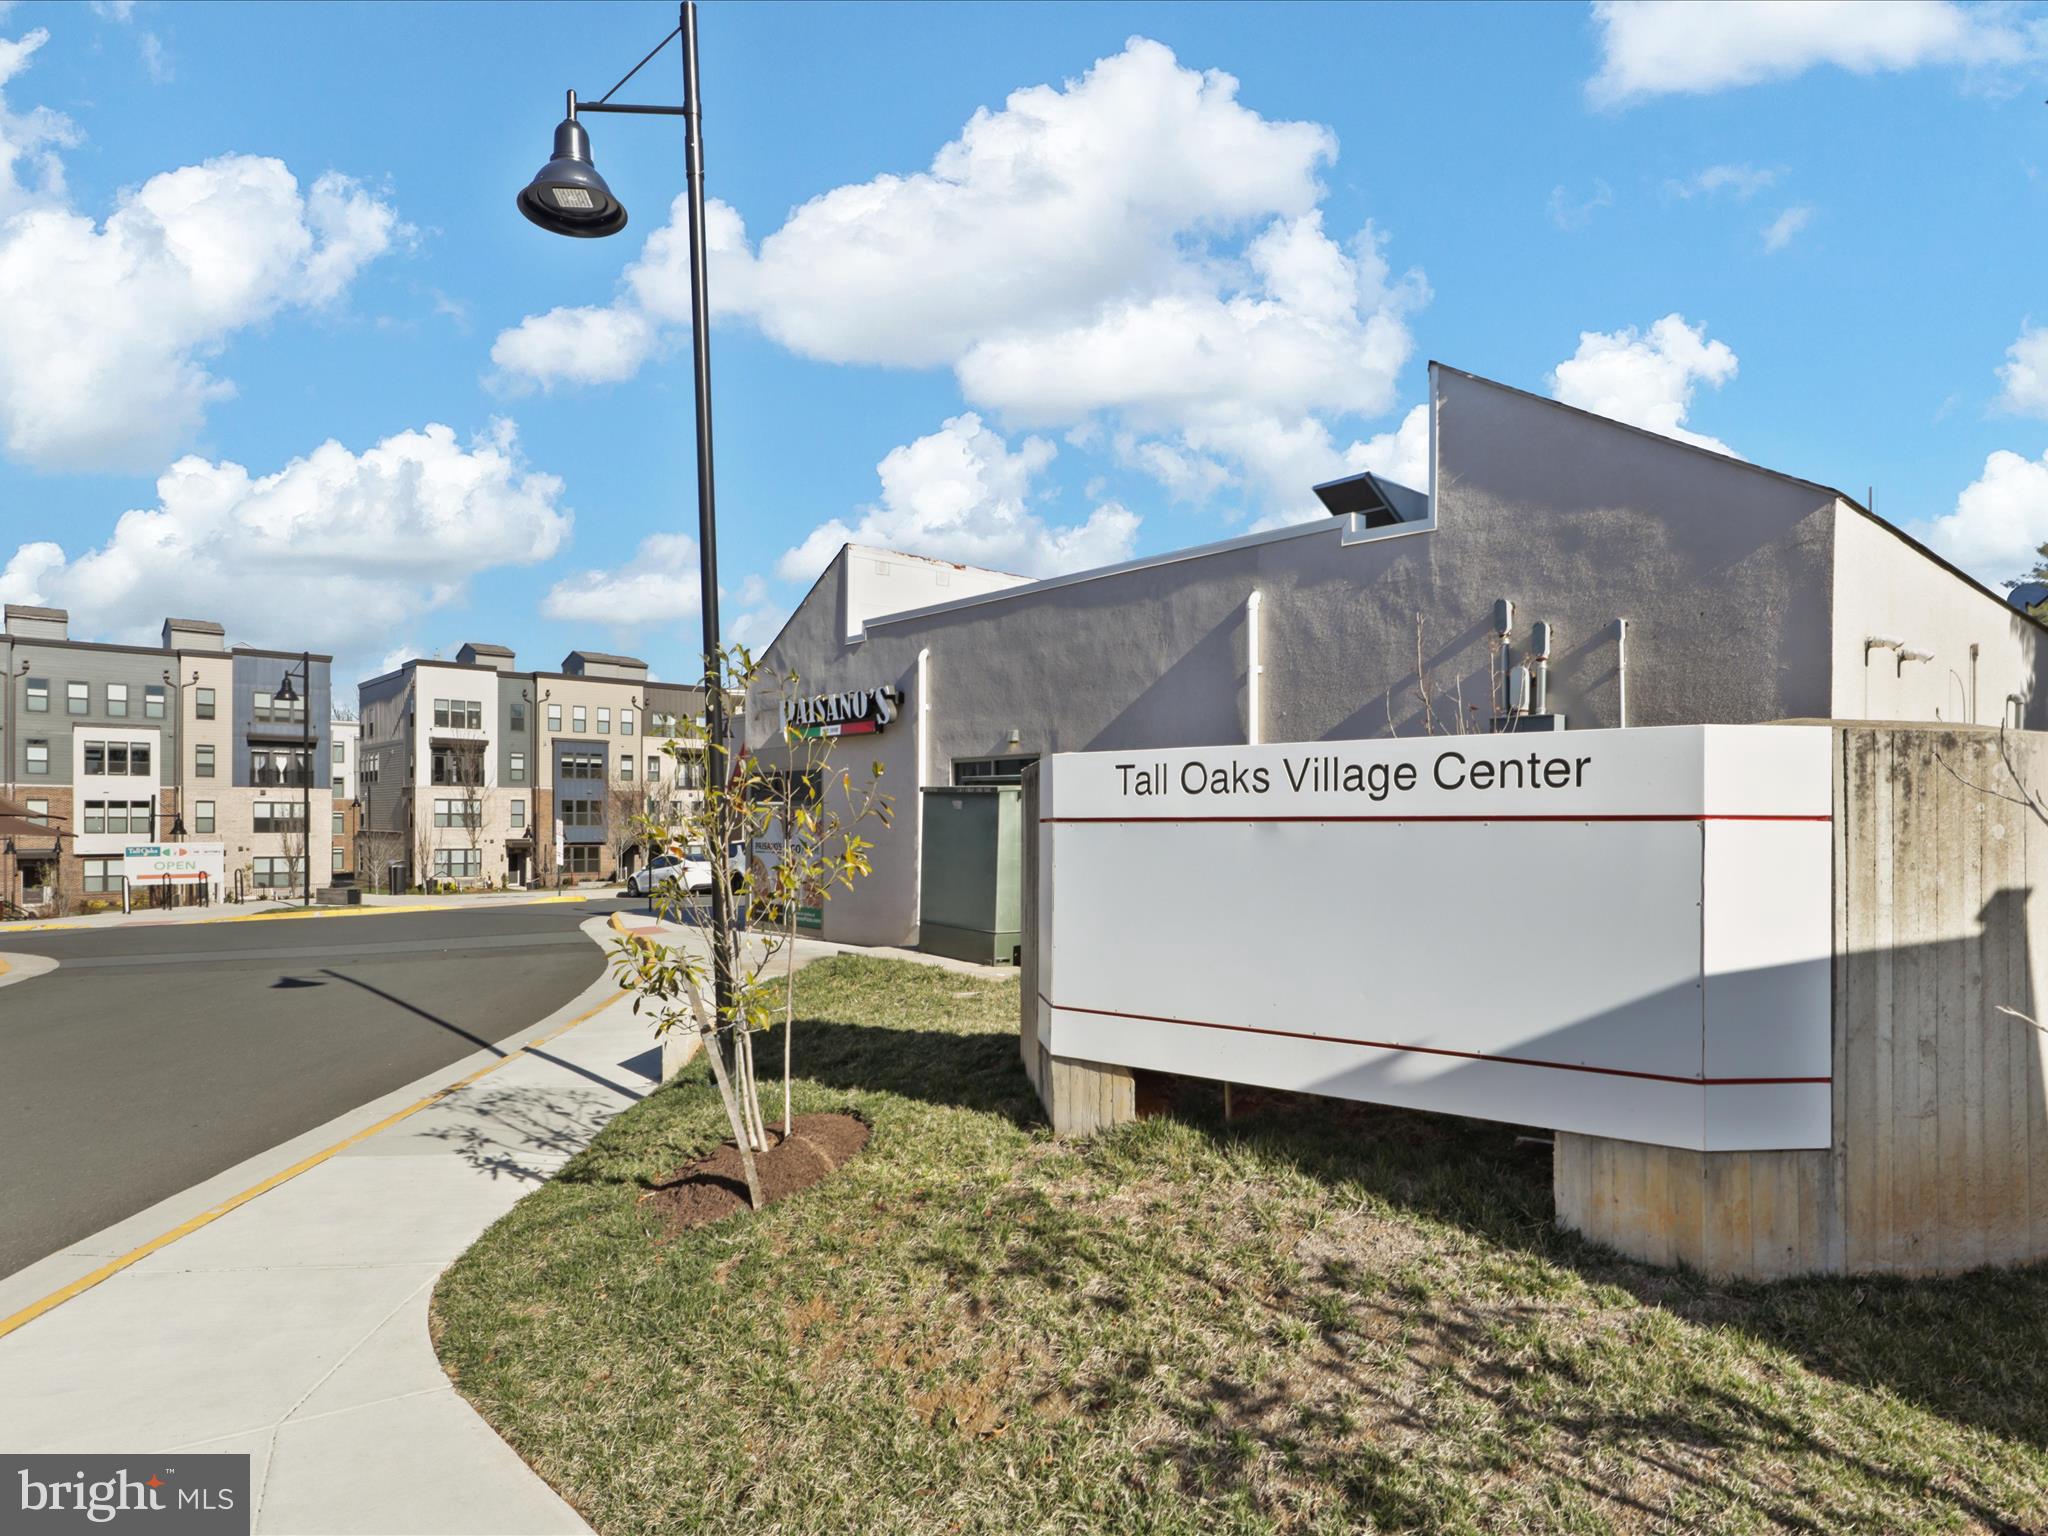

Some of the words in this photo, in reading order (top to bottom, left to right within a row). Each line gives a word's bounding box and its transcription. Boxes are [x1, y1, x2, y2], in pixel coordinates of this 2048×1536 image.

[779, 686, 892, 733] PAISANO'S
[1115, 763, 1168, 796] Tall
[1180, 760, 1270, 795] Oaks
[1282, 756, 1417, 802] Village
[1433, 751, 1592, 790] Center
[154, 861, 196, 870] OPEN
